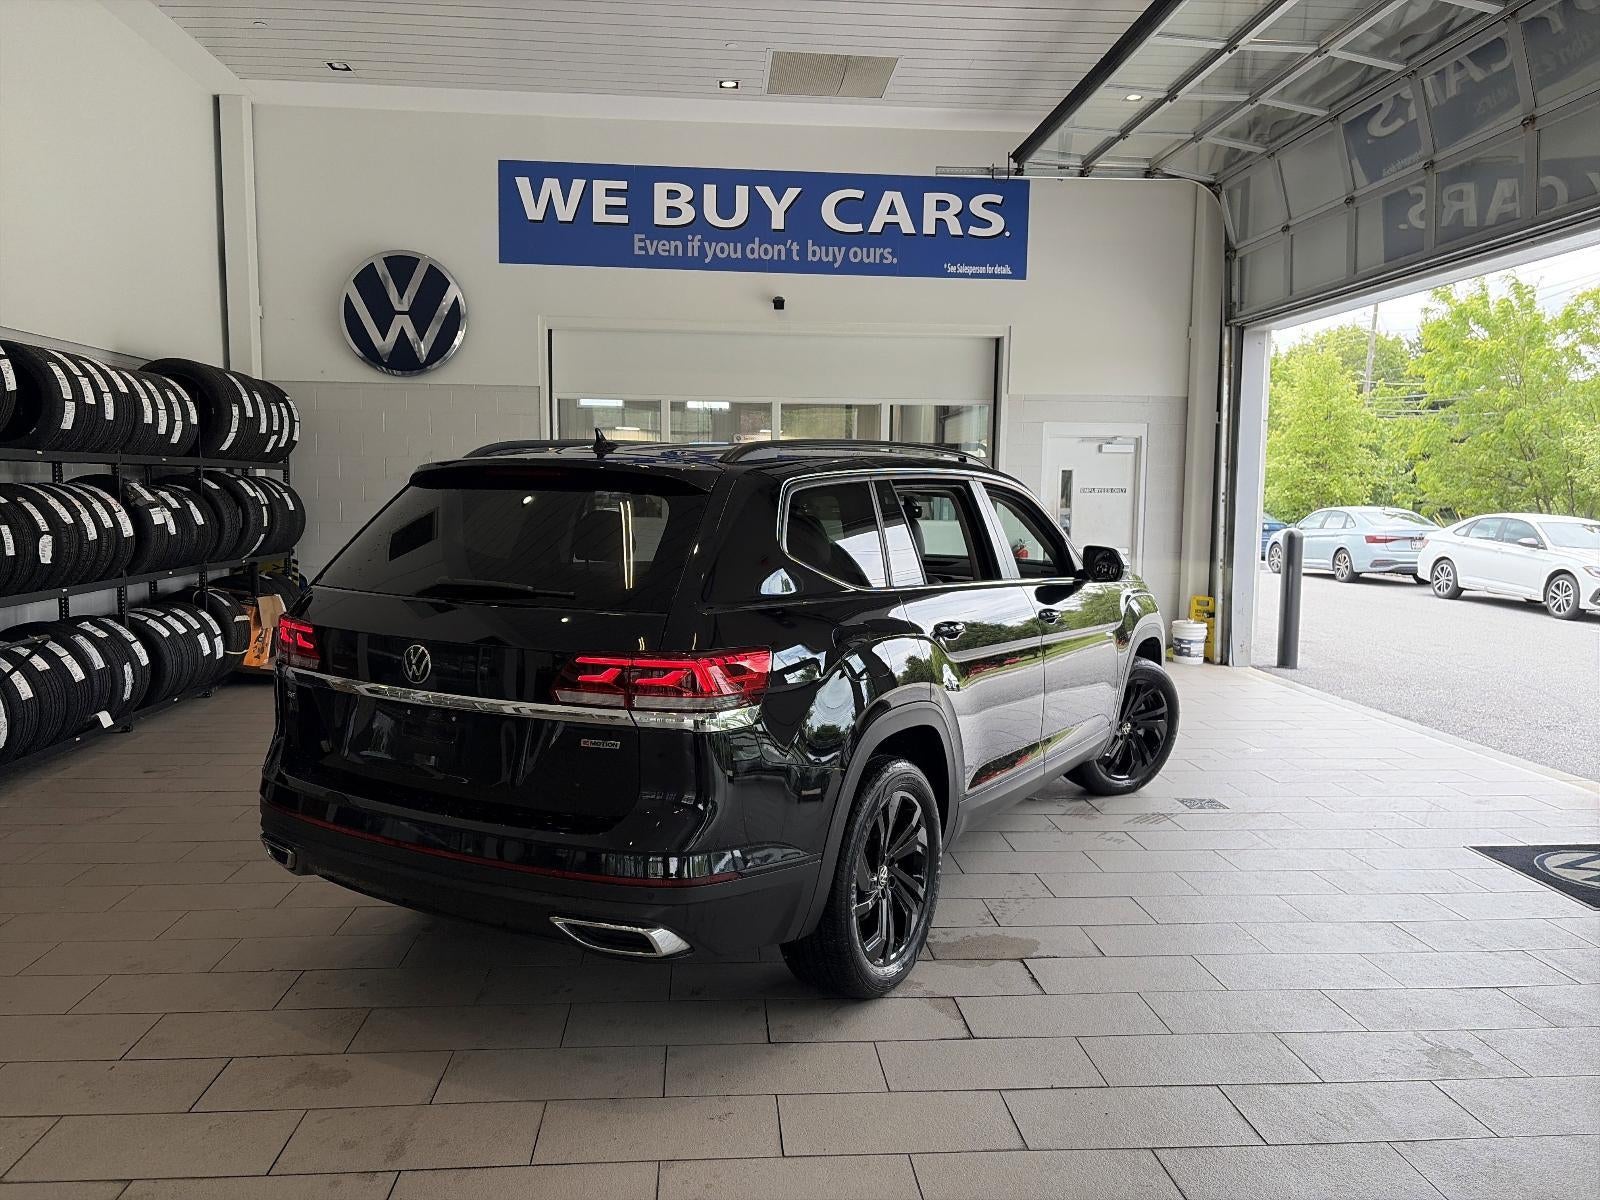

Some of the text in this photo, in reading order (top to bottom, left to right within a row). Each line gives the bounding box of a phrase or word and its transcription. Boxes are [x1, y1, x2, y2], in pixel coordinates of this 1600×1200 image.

[514, 176, 1011, 238] WE BUY CARS.
[633, 233, 898, 268] Even if you don't buy ours.
[957, 263, 986, 276] Salesperson
[986, 263, 994, 274] for
